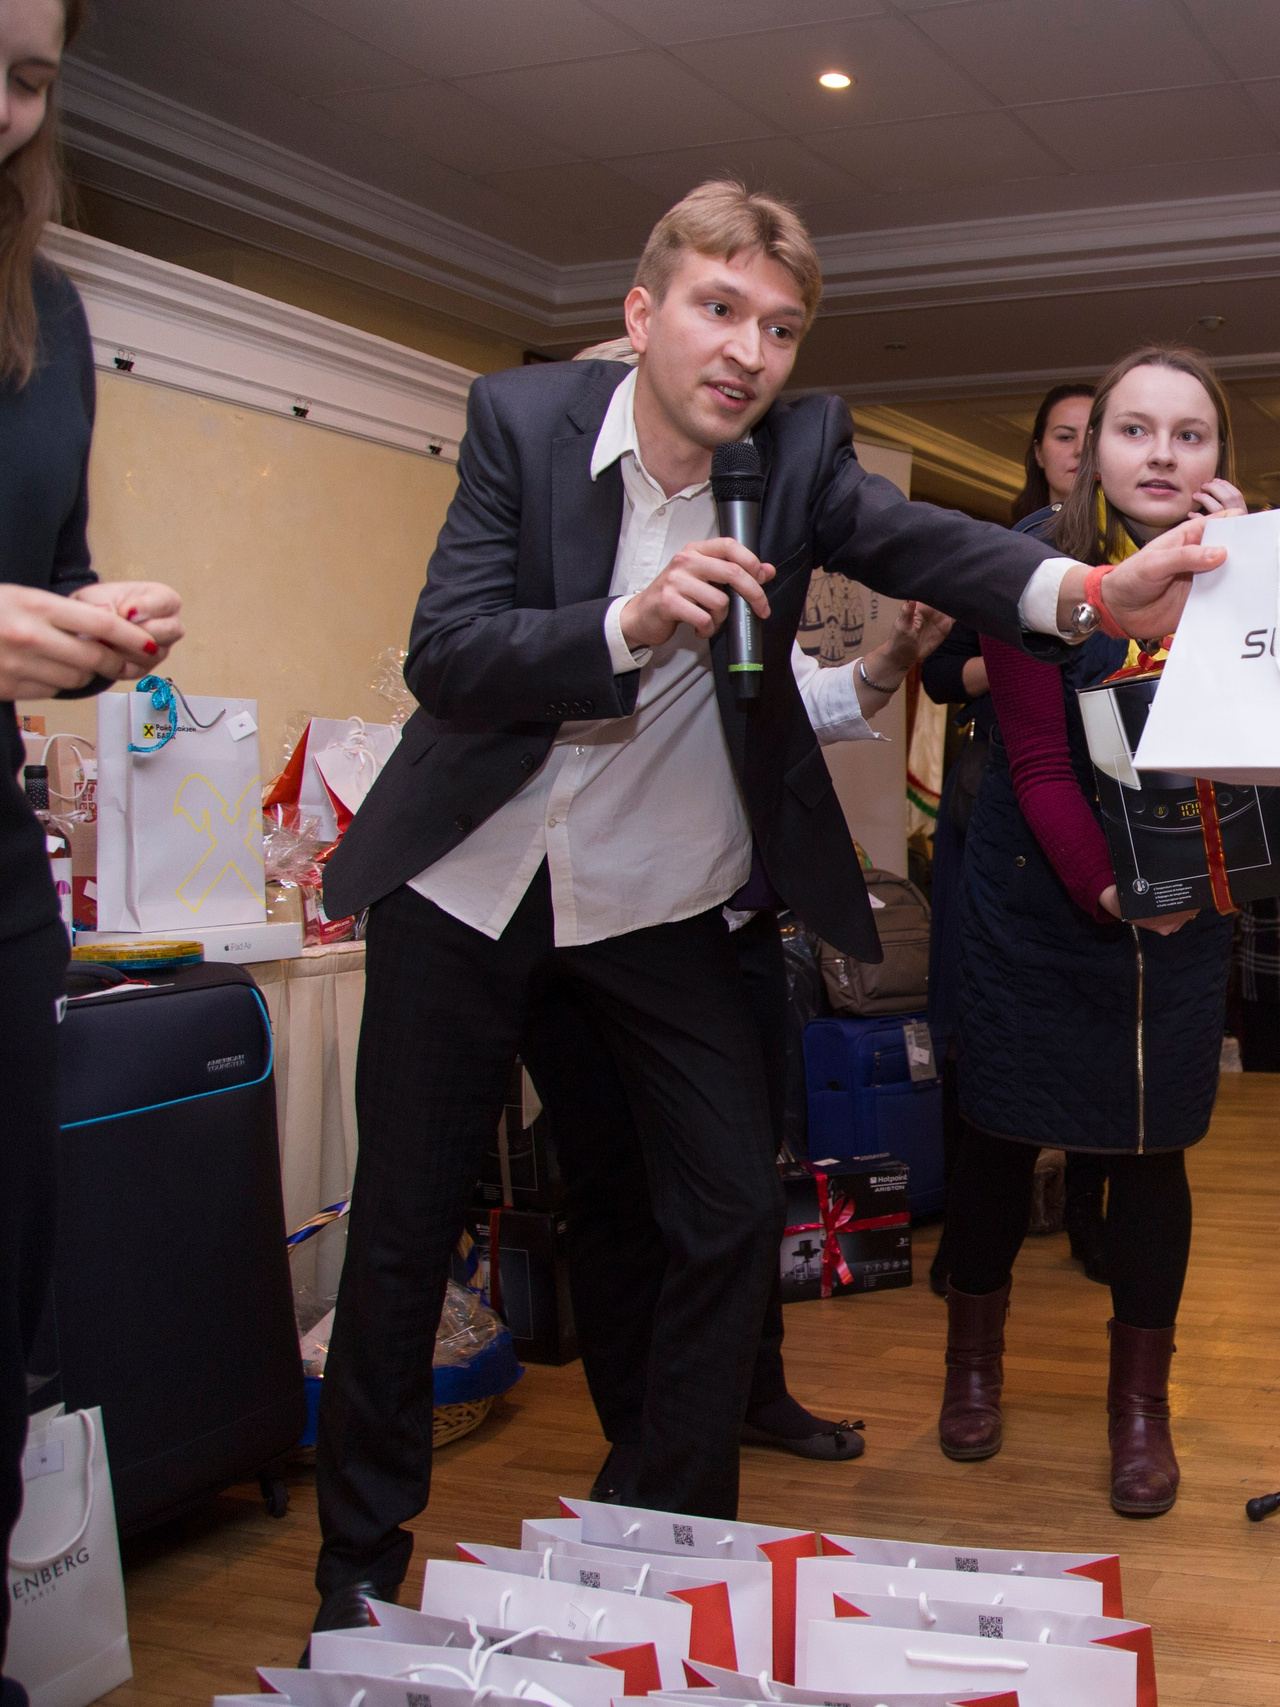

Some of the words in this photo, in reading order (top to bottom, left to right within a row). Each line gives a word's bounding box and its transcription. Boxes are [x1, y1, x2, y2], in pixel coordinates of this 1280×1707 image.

[156, 723, 197, 733] Райфайзен
[230, 943, 243, 951] iPad
[207, 1054, 245, 1066] AMERICAN
[878, 1174, 908, 1183] Hotpoint
[874, 1185, 905, 1193] ARISTON
[12, 1547, 90, 1600] ENBERG
